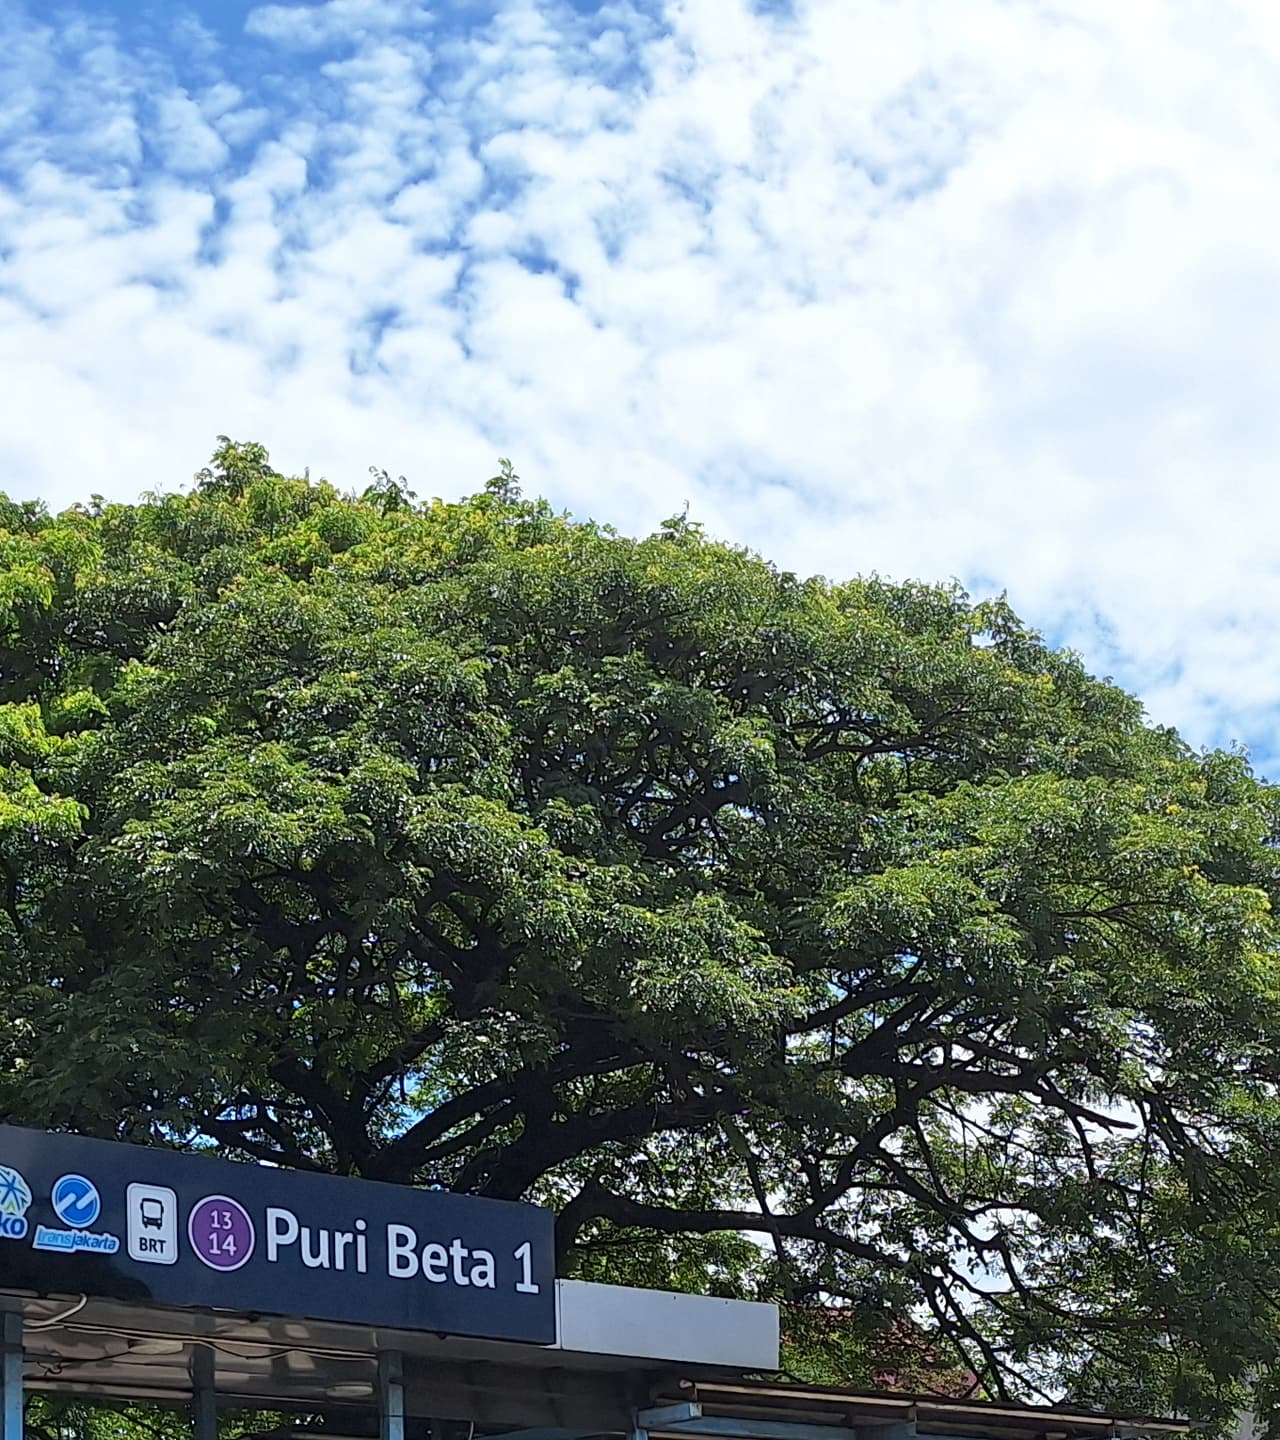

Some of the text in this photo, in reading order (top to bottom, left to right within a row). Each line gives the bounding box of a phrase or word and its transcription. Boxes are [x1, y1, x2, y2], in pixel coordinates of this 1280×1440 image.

[210, 1210, 233, 1230] 13
[37, 1227, 117, 1251] transjakarta
[138, 1236, 167, 1254] BRT
[208, 1234, 238, 1257] 14
[266, 1206, 540, 1295] Puri Beta 1
